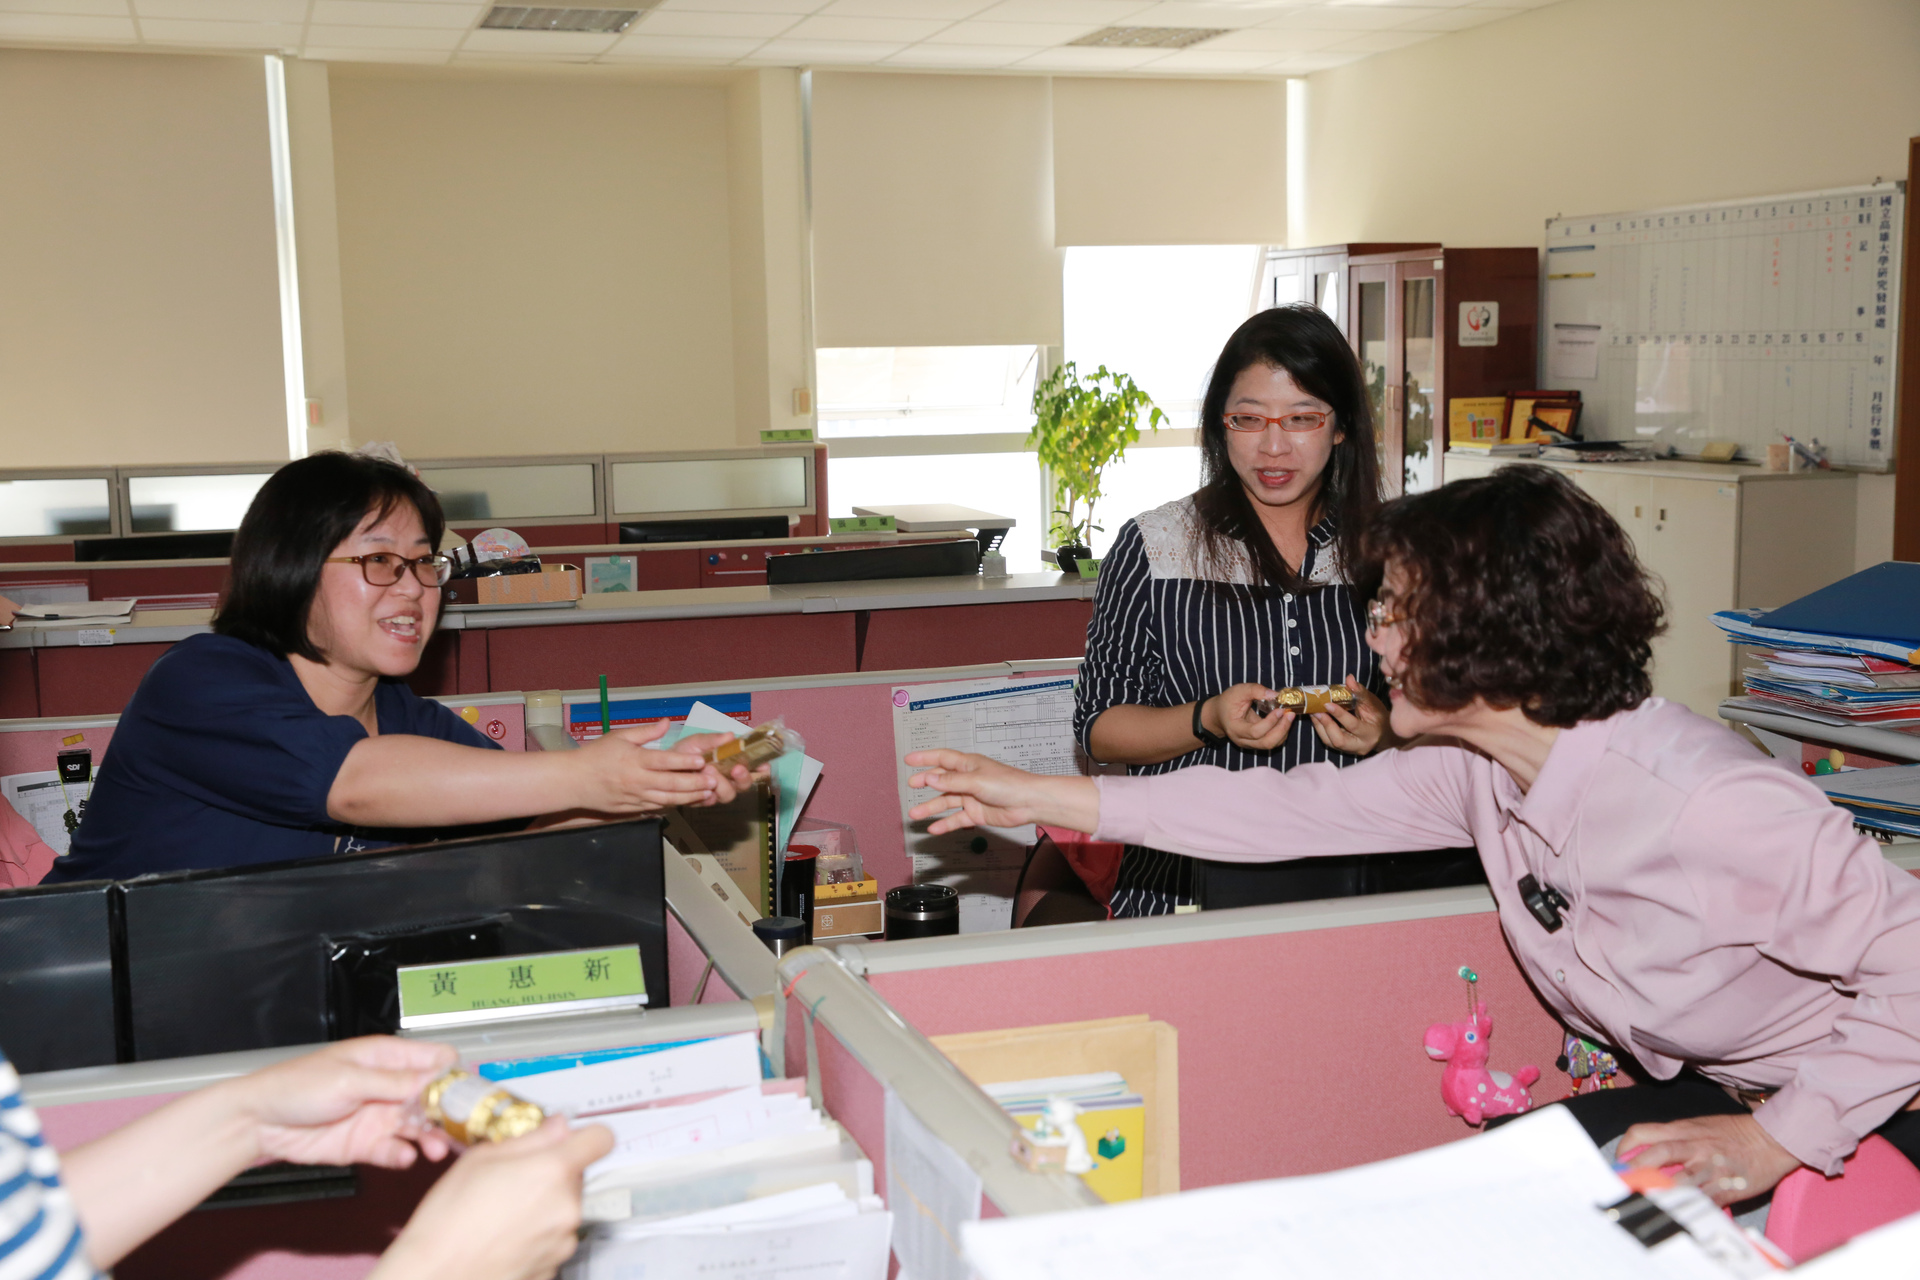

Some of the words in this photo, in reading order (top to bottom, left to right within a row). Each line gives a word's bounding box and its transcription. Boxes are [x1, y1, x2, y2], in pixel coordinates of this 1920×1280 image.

[67, 763, 80, 771] SDI
[429, 956, 611, 998] 黃惠新
